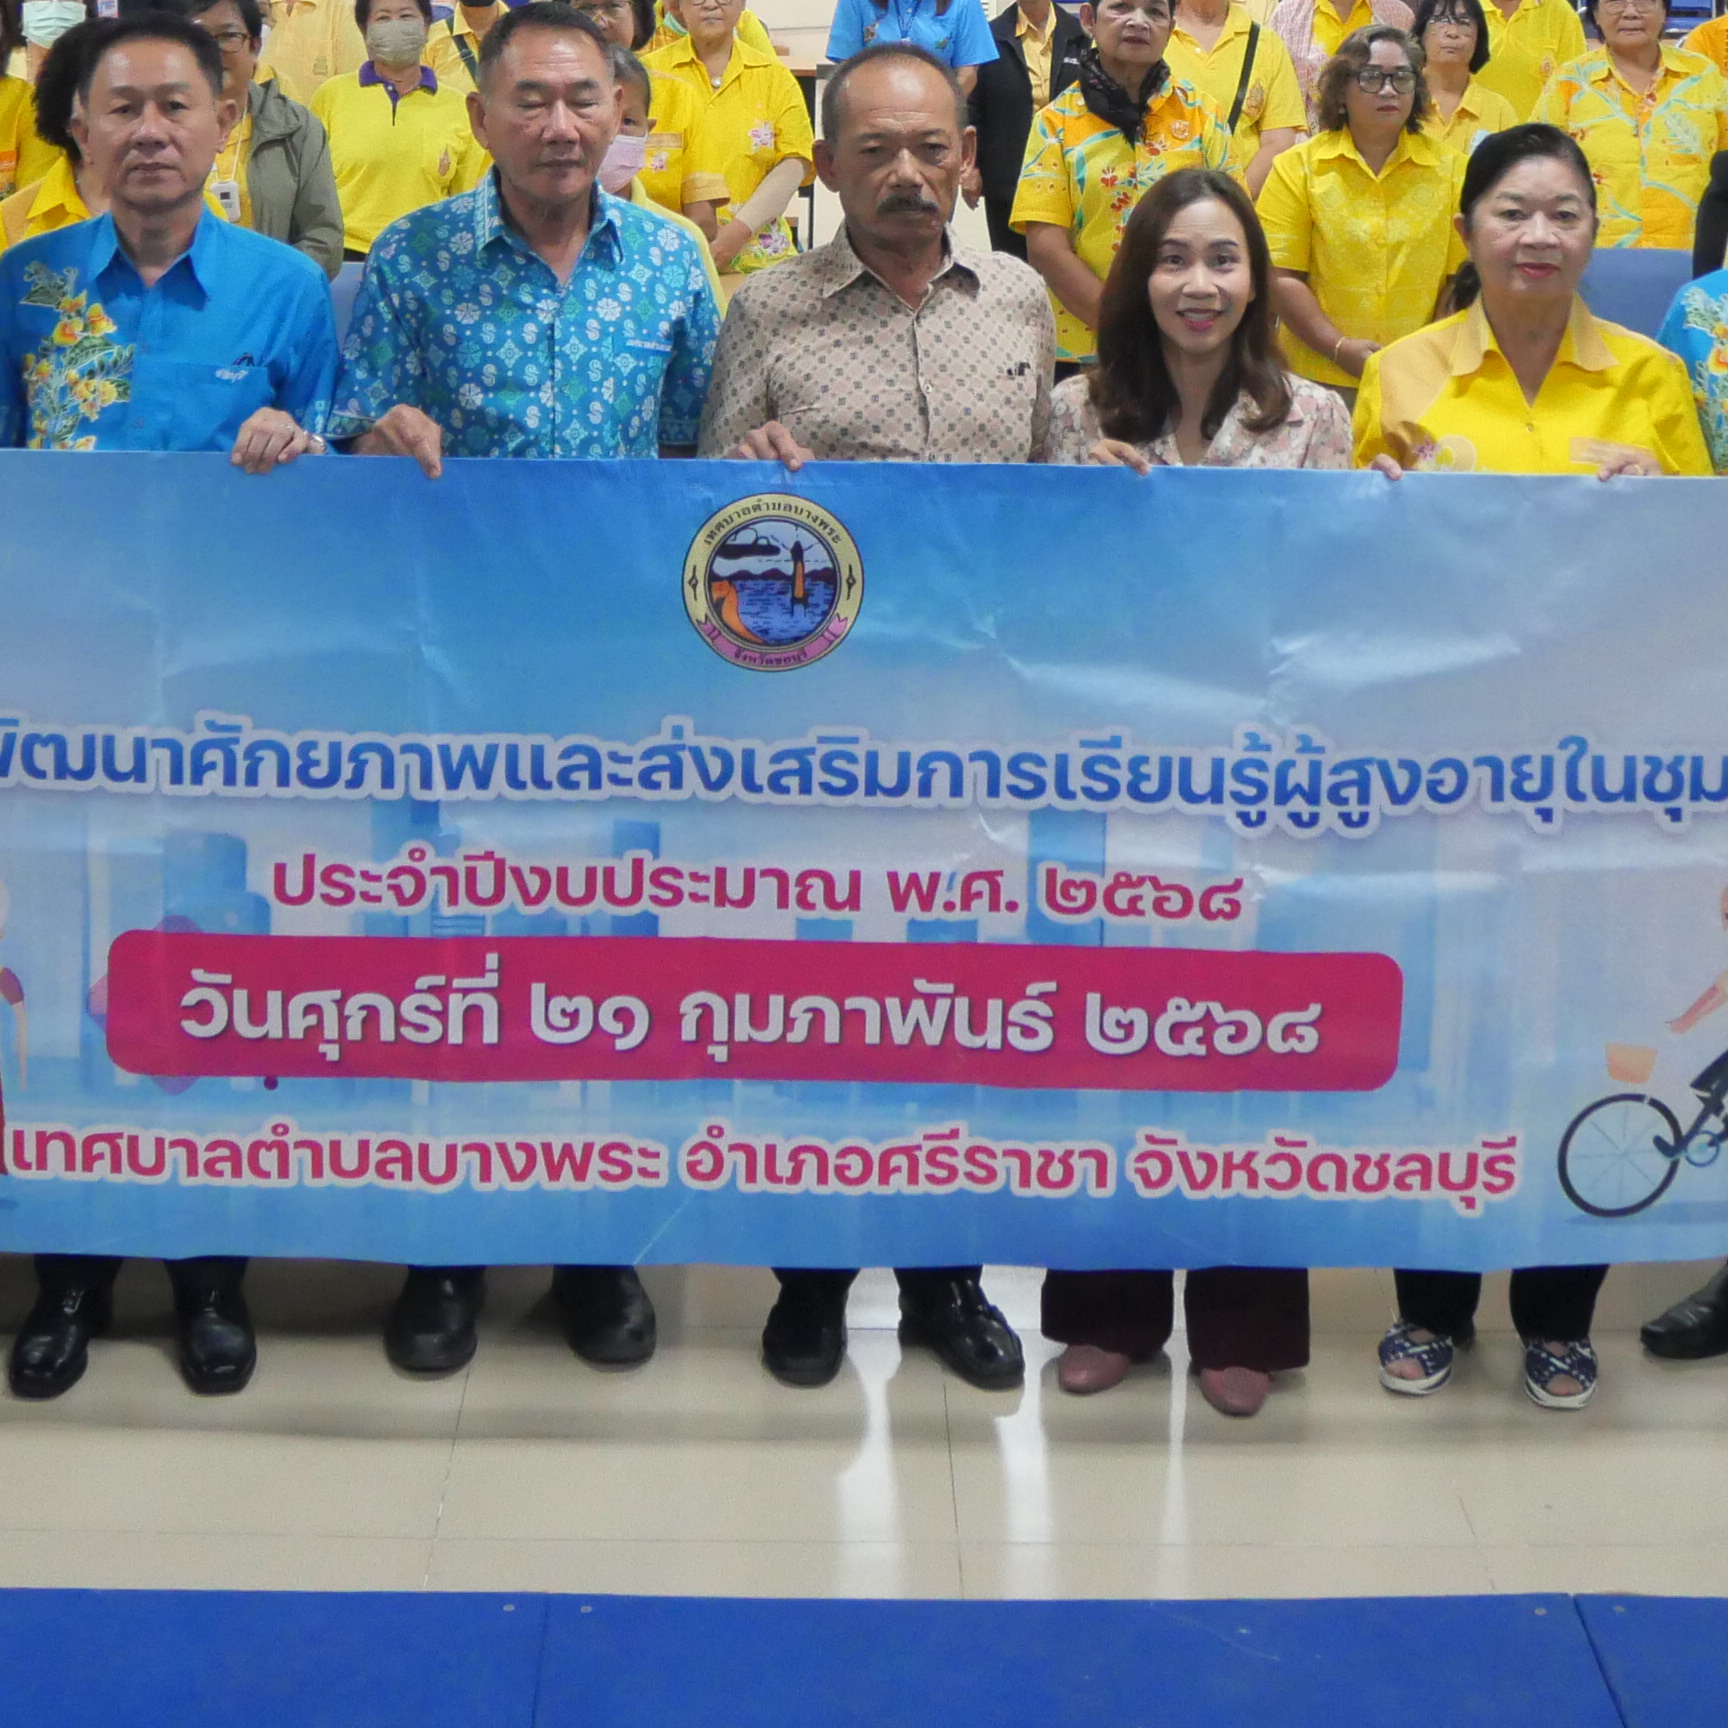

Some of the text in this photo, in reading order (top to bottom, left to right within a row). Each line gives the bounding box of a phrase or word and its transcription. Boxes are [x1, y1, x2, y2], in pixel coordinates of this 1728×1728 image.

[272, 849, 1243, 920] ประจำปีงบประมาณ พ.ศ. ๒๕๖๘
[180, 953, 1321, 1062] วันศุกร์ที่ ๒๑ กุมภาพันธ์ ๒๕๖๘
[13, 1123, 1517, 1210] เทศบาลตำบลบางพระ อำเภอศรีราชา จังหวัดชลบุรี
